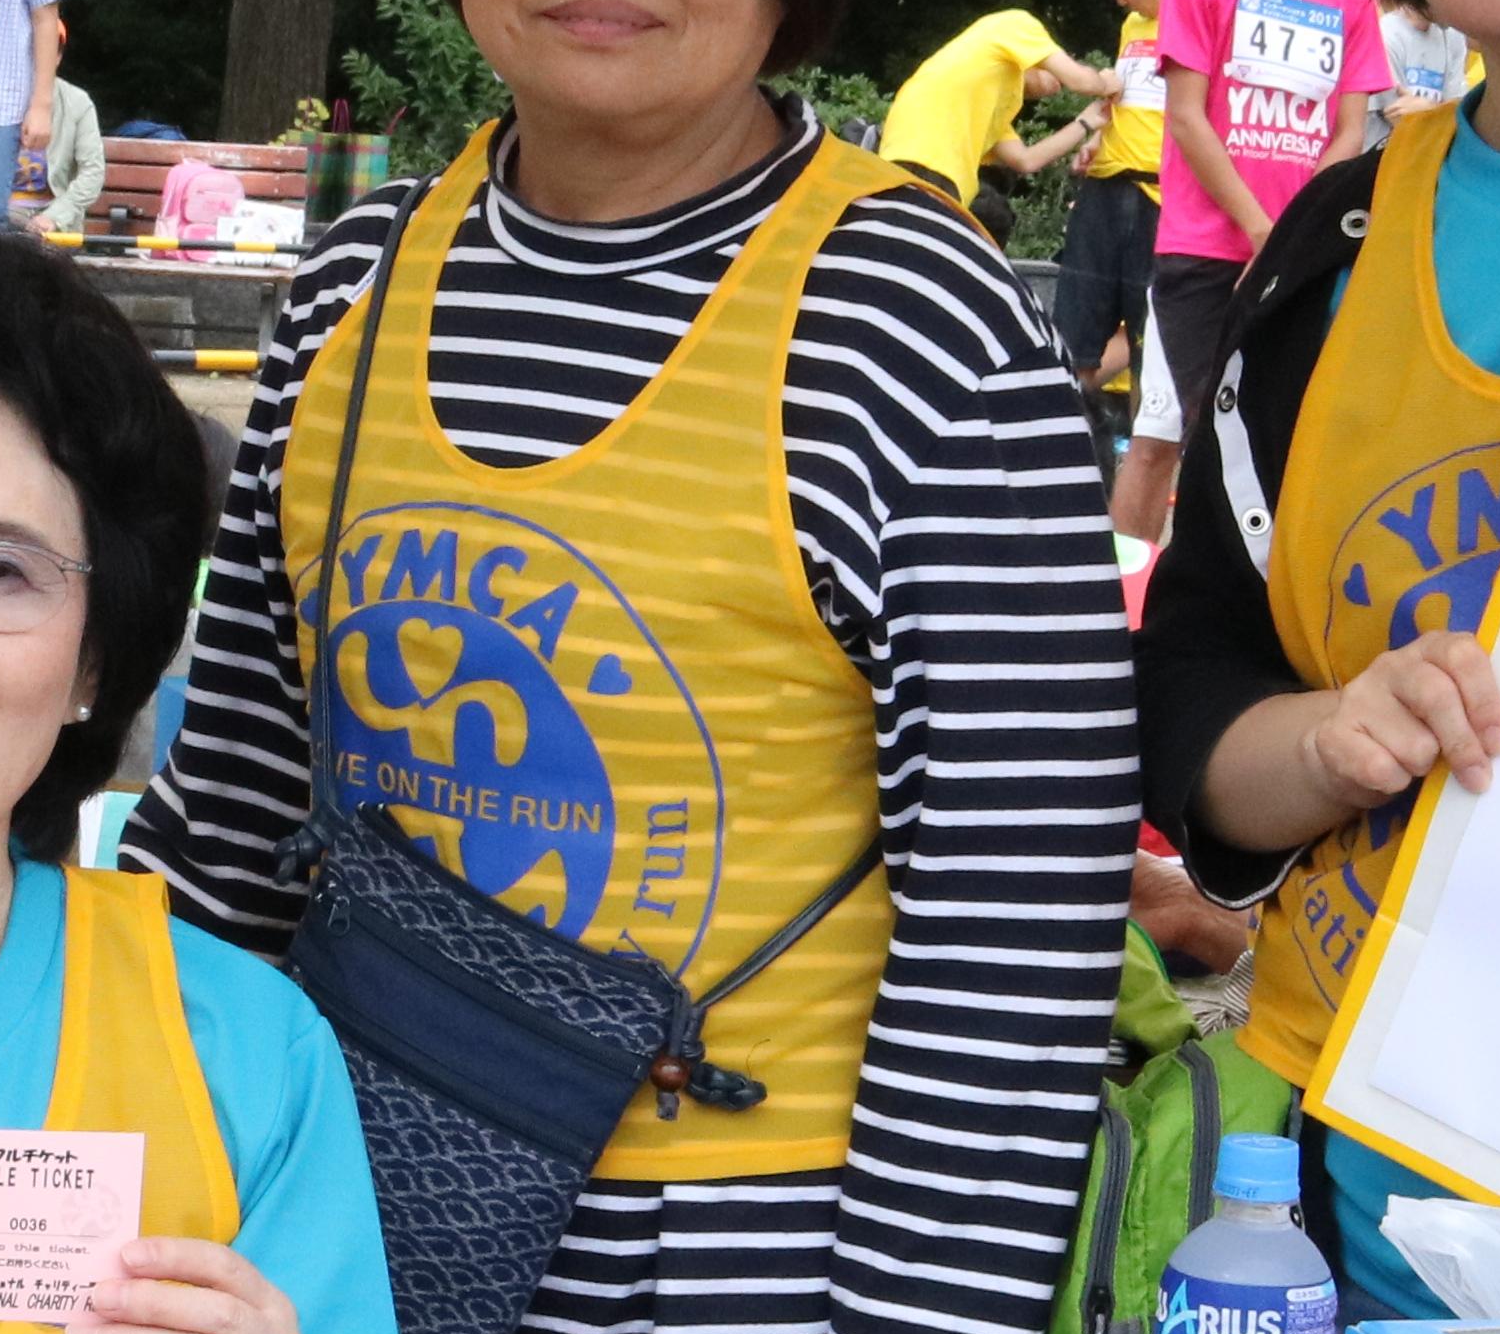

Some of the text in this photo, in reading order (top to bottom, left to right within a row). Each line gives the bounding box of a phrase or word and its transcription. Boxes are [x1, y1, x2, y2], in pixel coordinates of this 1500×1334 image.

[1308, 9, 1340, 28] 2017
[1227, 87, 1328, 138] YMCA
[341, 528, 581, 663] YMCA
[428, 774, 500, 822] THE
[511, 794, 601, 834] RUN
[633, 797, 689, 920] run
[31, 1167, 96, 1190] TICKET
[9, 1217, 48, 1233] 0036
[26, 1293, 79, 1311] CHARITY
